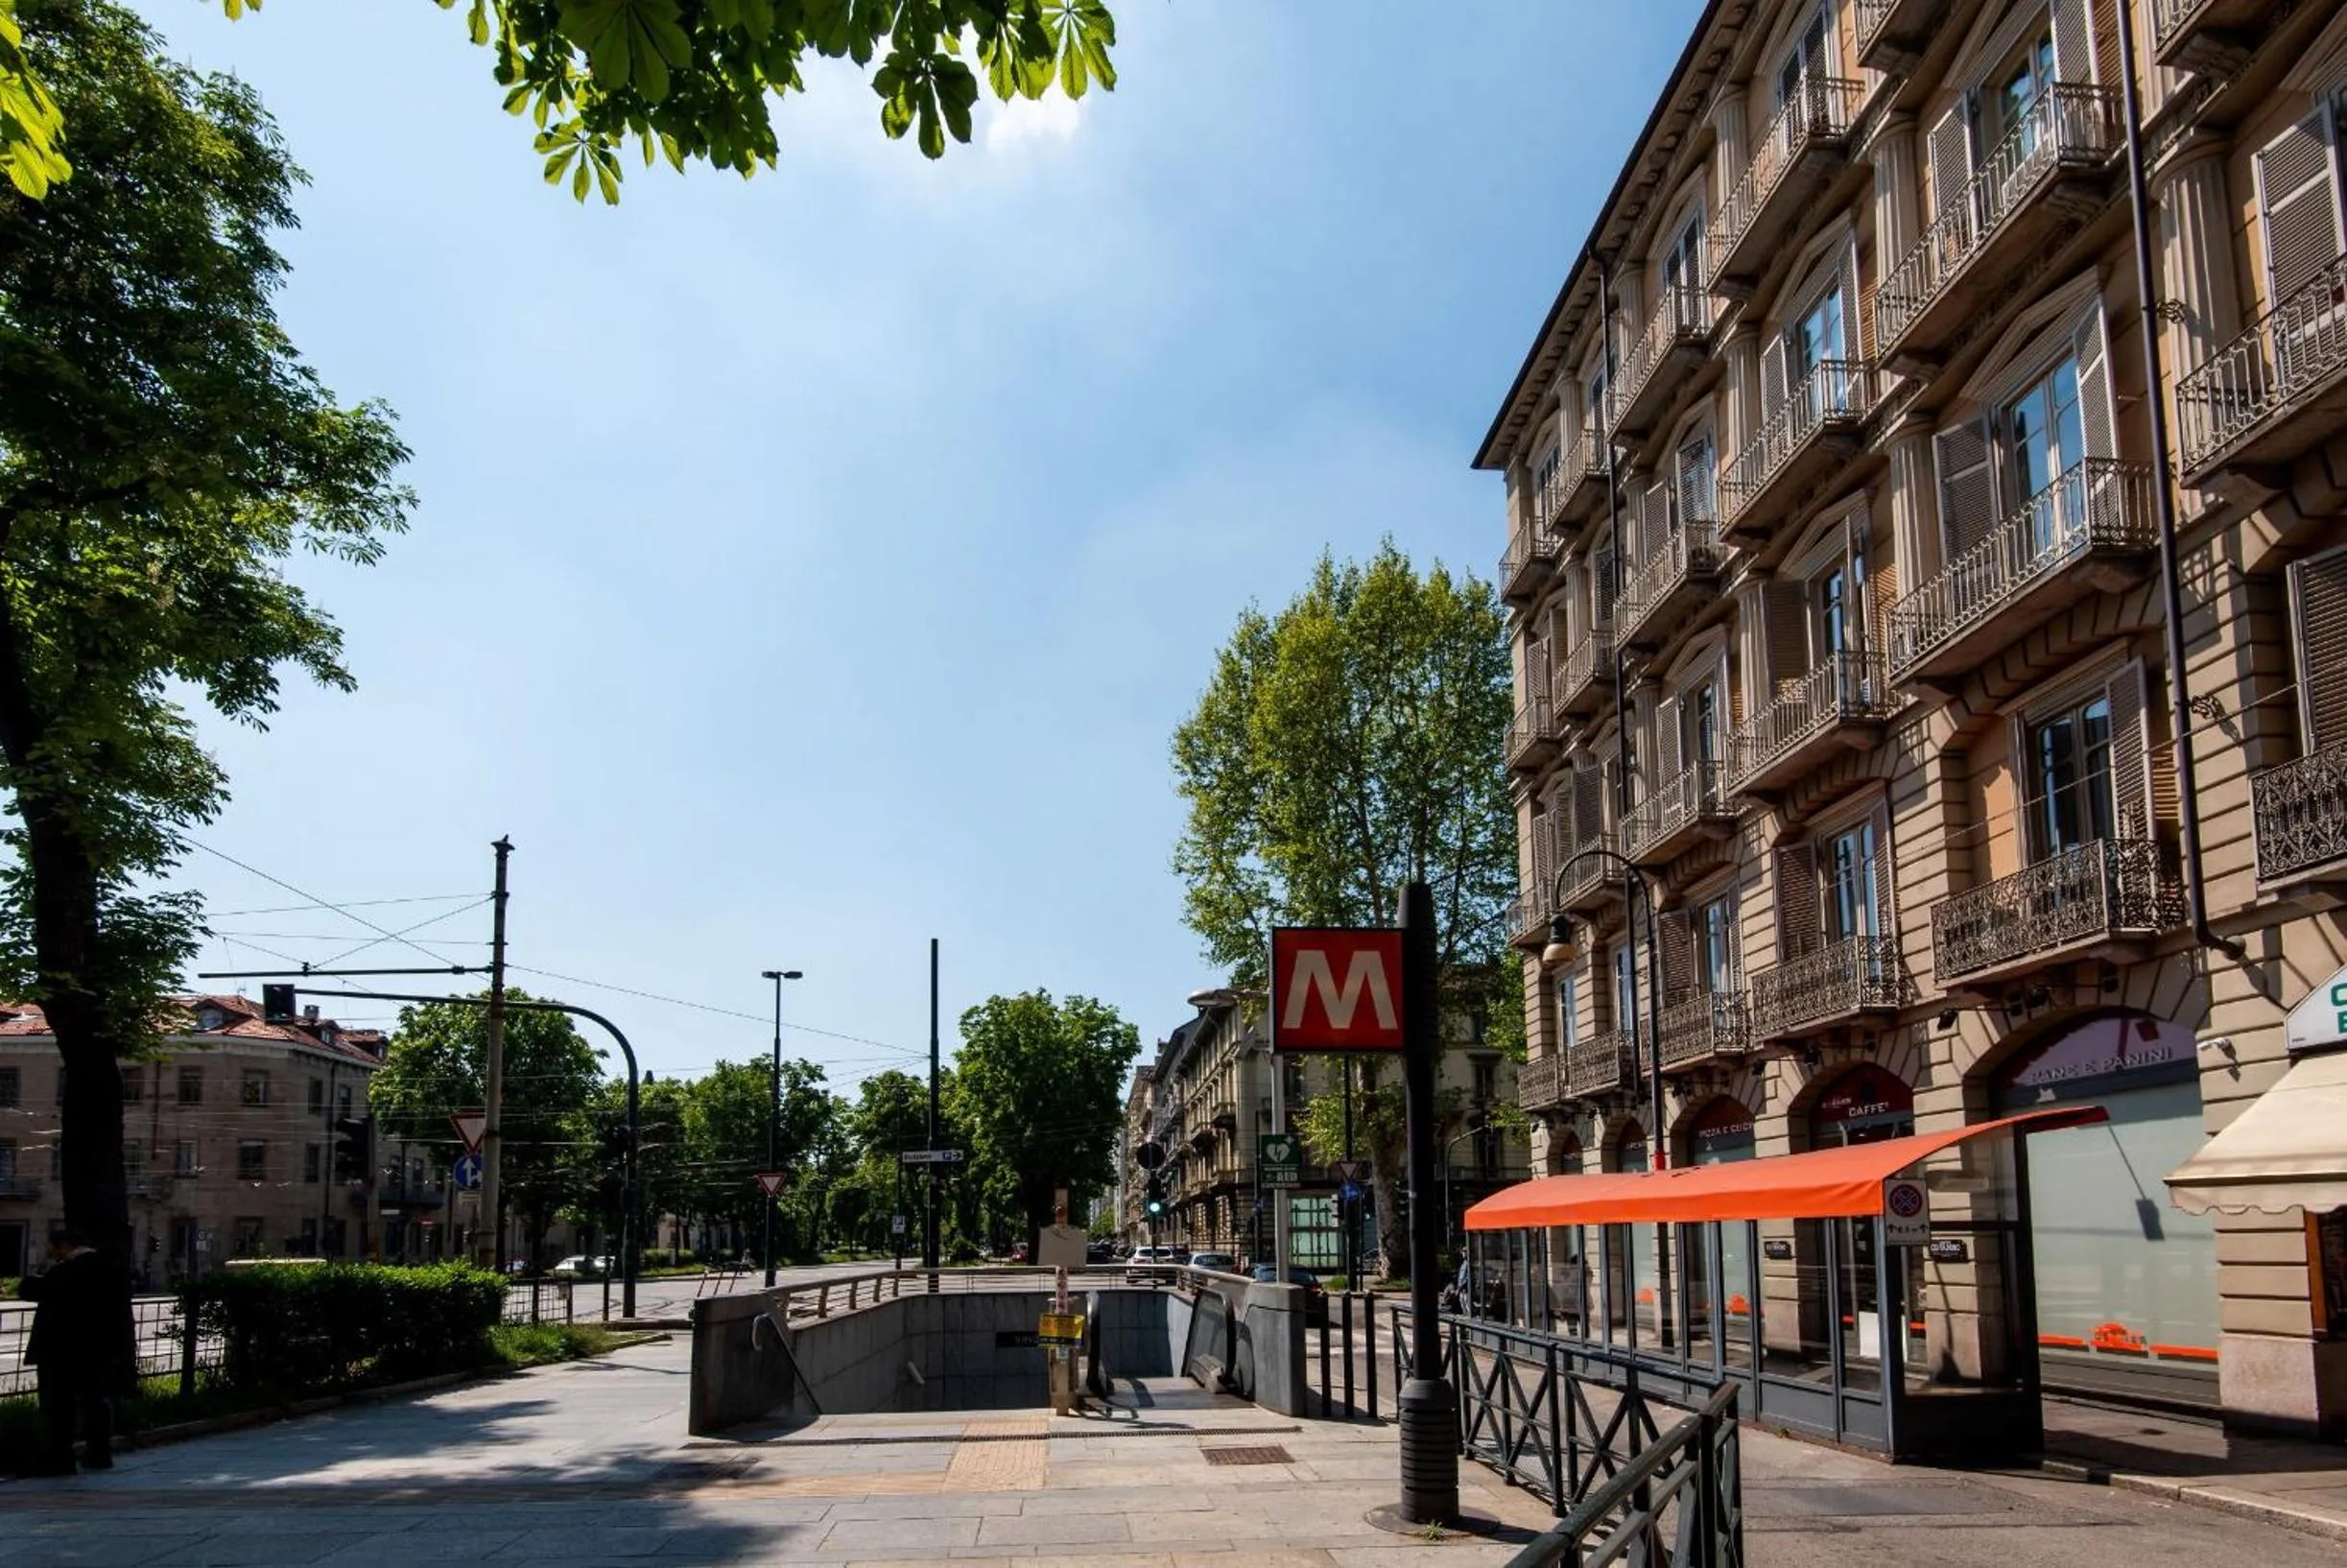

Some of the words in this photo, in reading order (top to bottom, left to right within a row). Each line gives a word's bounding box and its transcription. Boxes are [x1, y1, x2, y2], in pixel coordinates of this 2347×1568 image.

[1282, 949, 1398, 1030] M
[2031, 1062, 2079, 1082] PANE
[2101, 1045, 2173, 1072] PANINI
